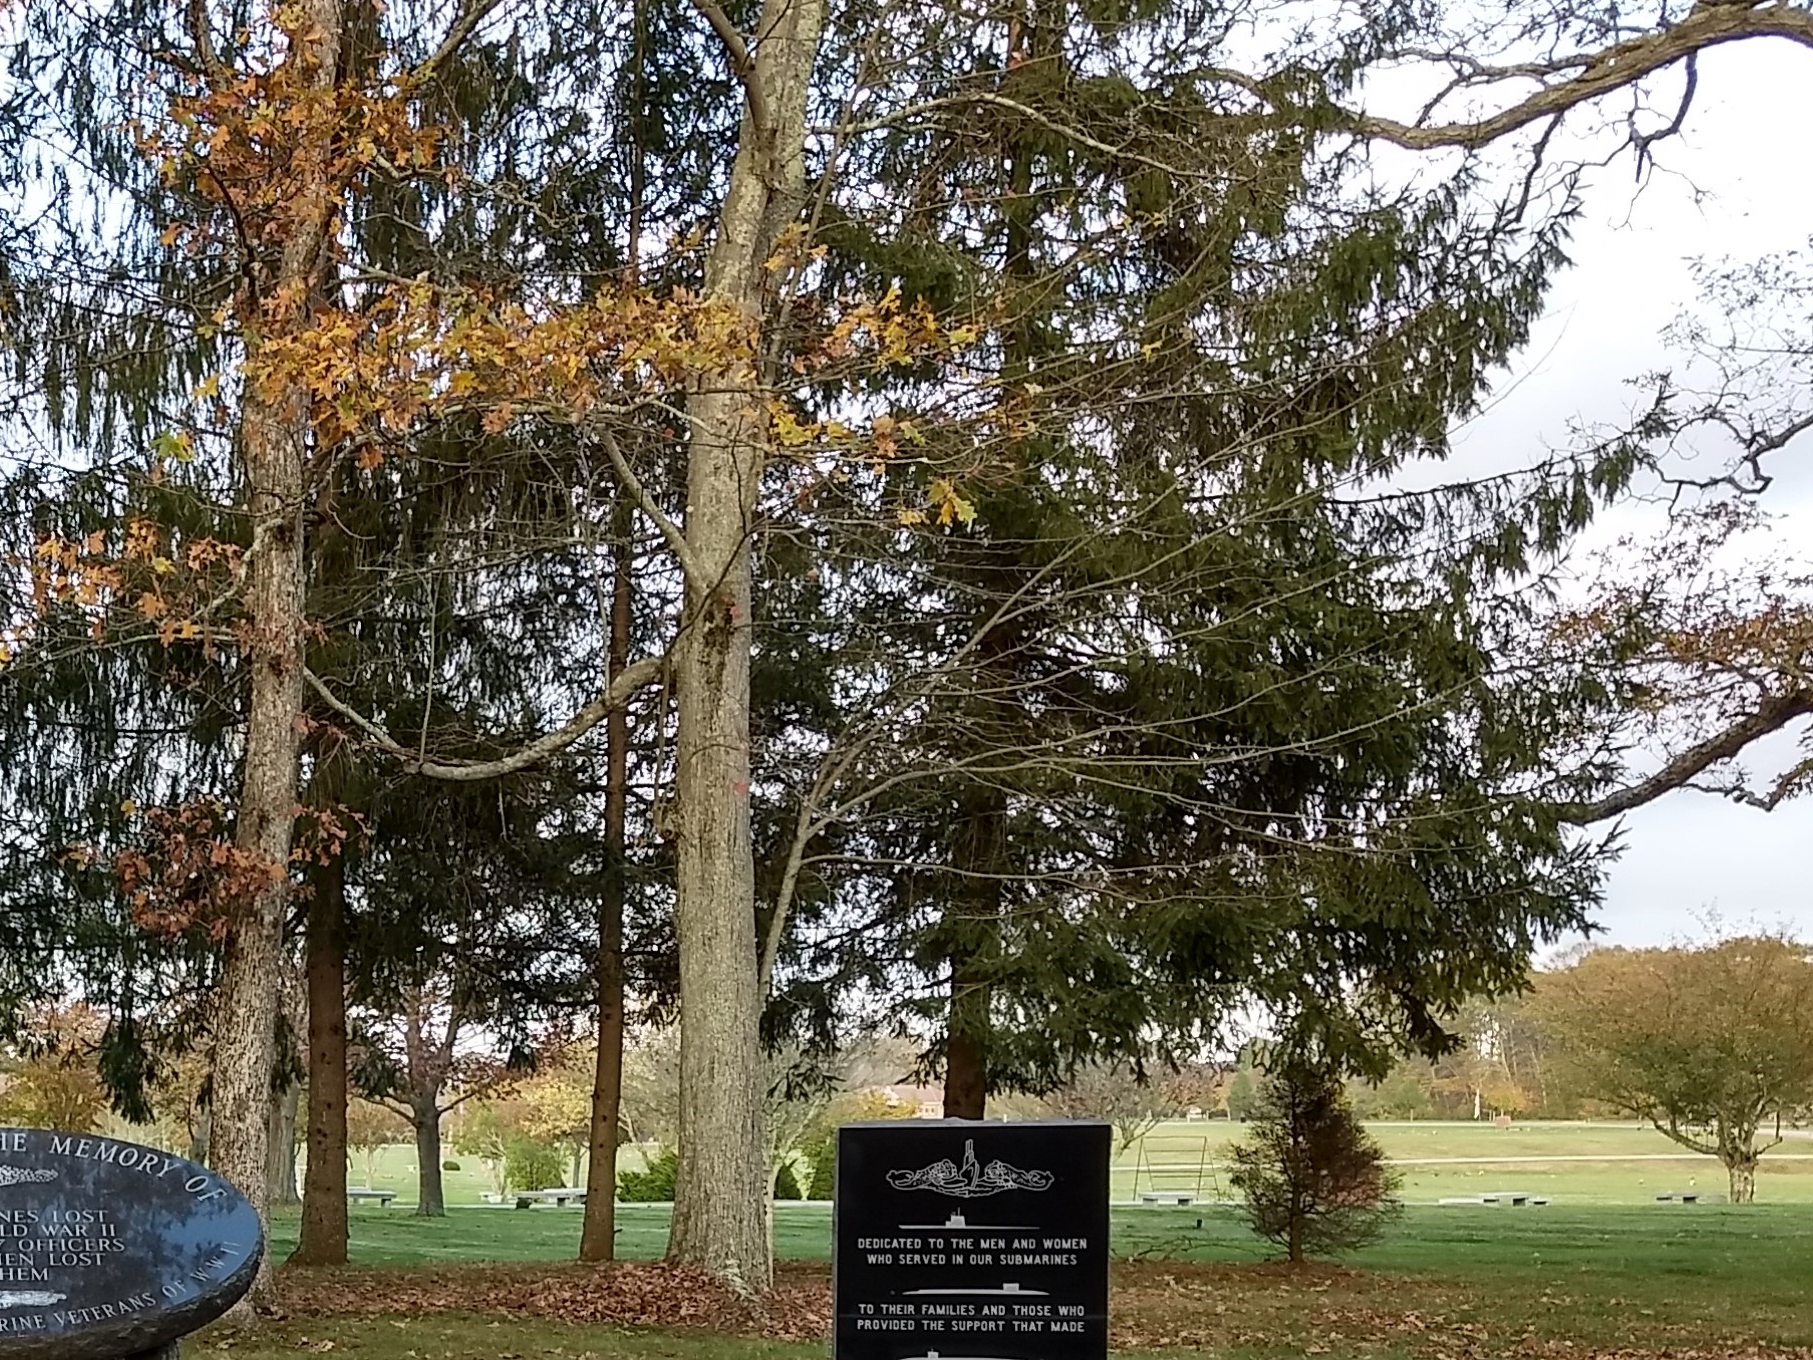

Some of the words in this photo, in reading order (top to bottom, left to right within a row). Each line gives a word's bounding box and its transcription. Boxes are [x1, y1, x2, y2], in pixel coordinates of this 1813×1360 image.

[48, 1135, 181, 1178] MEMORY
[184, 1174, 228, 1204] OF
[52, 1210, 109, 1223] LOST
[41, 1223, 89, 1238] WAR
[101, 1223, 116, 1238] II
[18, 1238, 126, 1252] OFFICERS
[857, 1238, 922, 1249] DEDICATED
[927, 1238, 944, 1249] TO
[950, 1238, 974, 1249] THE
[980, 1238, 1006, 1249] MEN
[1012, 1238, 1037, 1249] AND
[1042, 1238, 1088, 1249] WOMEN
[48, 1252, 106, 1267] LOST
[866, 1254, 893, 1265] WHO
[898, 1254, 946, 1265] SERVED
[952, 1254, 964, 1265] IN
[969, 1254, 993, 1265] OUR
[999, 1254, 1078, 1266] SUBMARINES
[52, 1291, 158, 1328] VETERANS
[160, 1279, 188, 1299] OF
[857, 1303, 874, 1315] TO
[880, 1303, 916, 1315] THEIR
[921, 1304, 976, 1316] FAMILIES
[981, 1304, 1006, 1316] AND
[1012, 1305, 1052, 1316] THOSE
[1057, 1305, 1085, 1317] WHO
[856, 1319, 915, 1331] PROVIDED
[921, 1320, 945, 1331] THE
[951, 1320, 1006, 1332] SUPPORT
[1012, 1321, 1045, 1332] THAT
[1050, 1321, 1085, 1333] MADE
